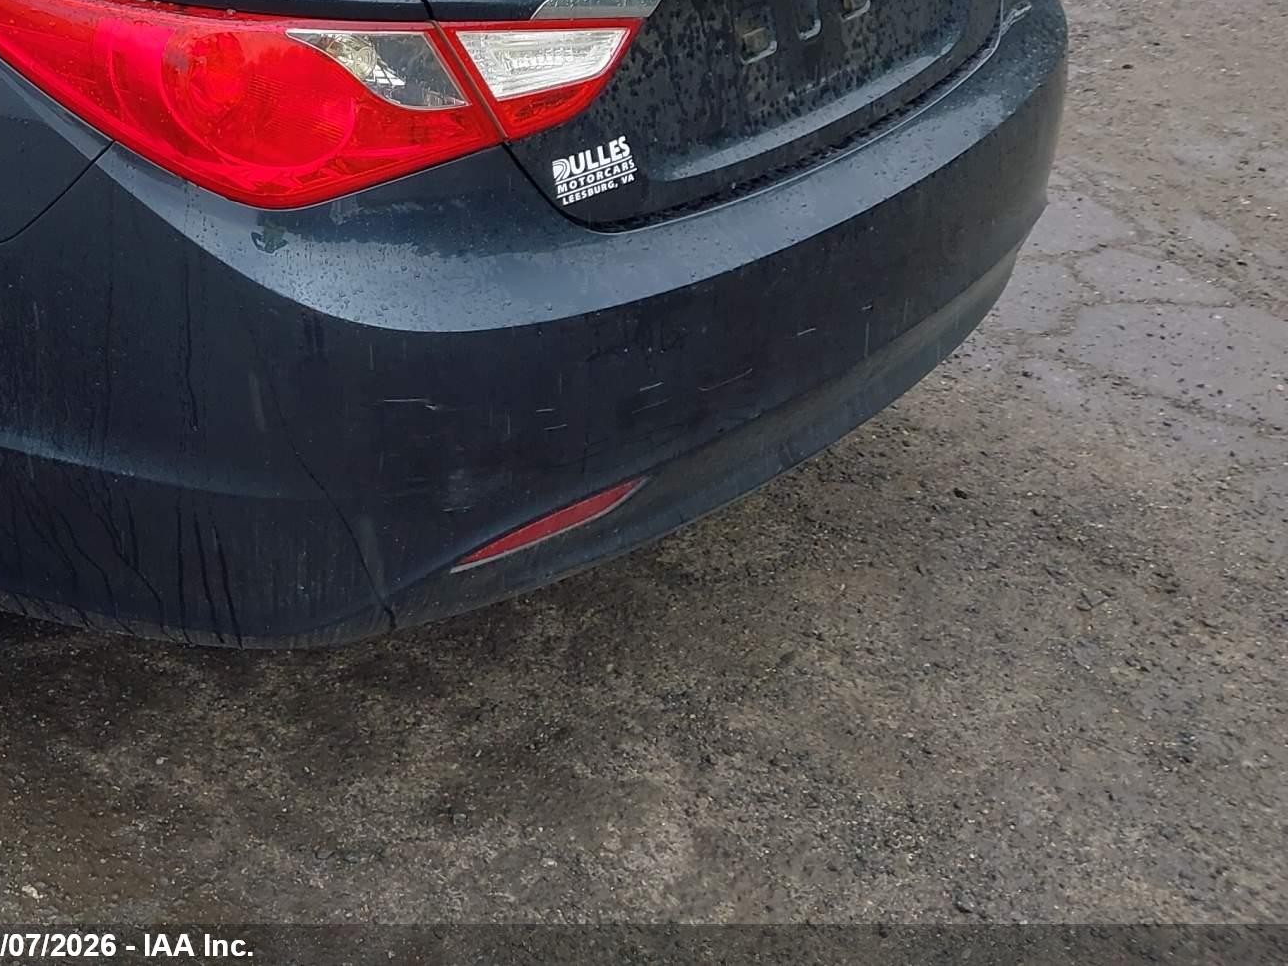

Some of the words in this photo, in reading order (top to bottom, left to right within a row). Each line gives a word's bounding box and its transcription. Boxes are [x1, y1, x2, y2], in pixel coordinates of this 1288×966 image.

[552, 135, 631, 182] DULLES
[557, 159, 635, 195] MOTORCARS
[562, 180, 619, 206] LEESBURG,
[620, 173, 635, 185] VA
